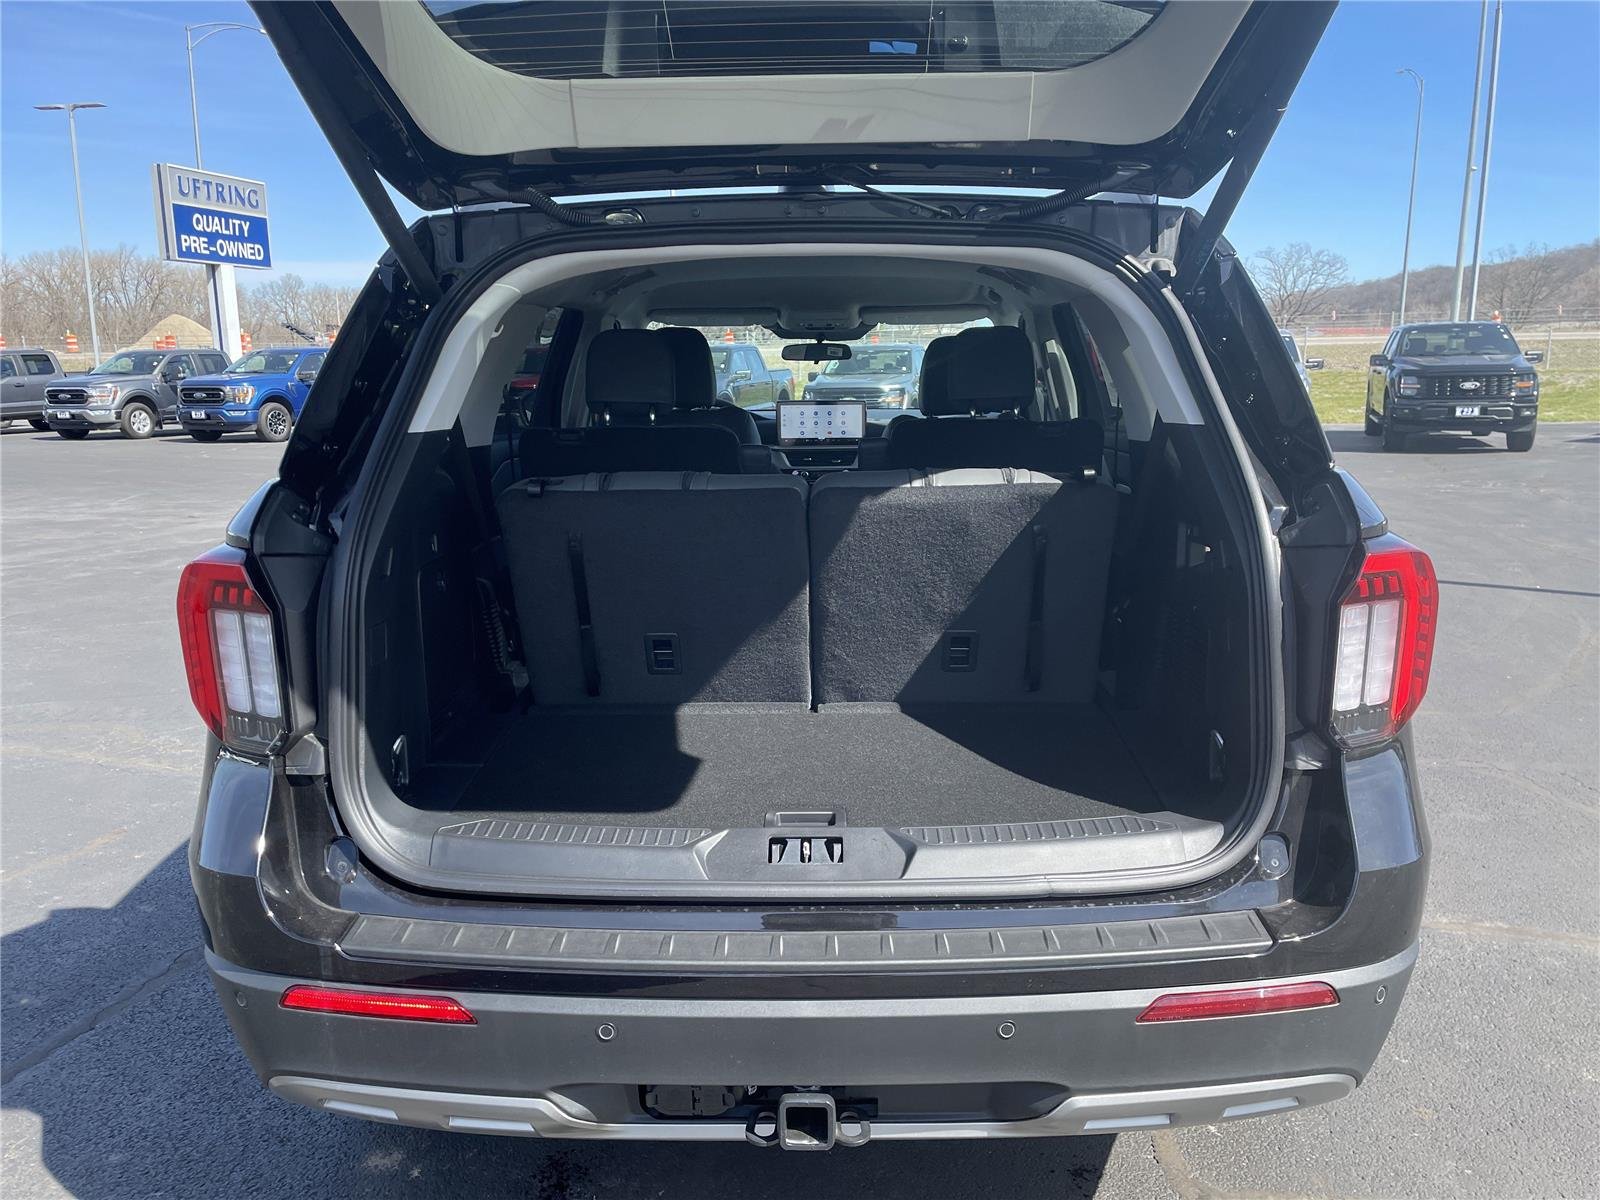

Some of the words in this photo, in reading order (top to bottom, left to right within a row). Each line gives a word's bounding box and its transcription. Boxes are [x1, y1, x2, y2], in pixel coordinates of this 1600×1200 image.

[177, 175, 259, 209] UFTRING
[192, 213, 250, 237] QUALITY
[180, 234, 264, 261] PRE-OWNED
